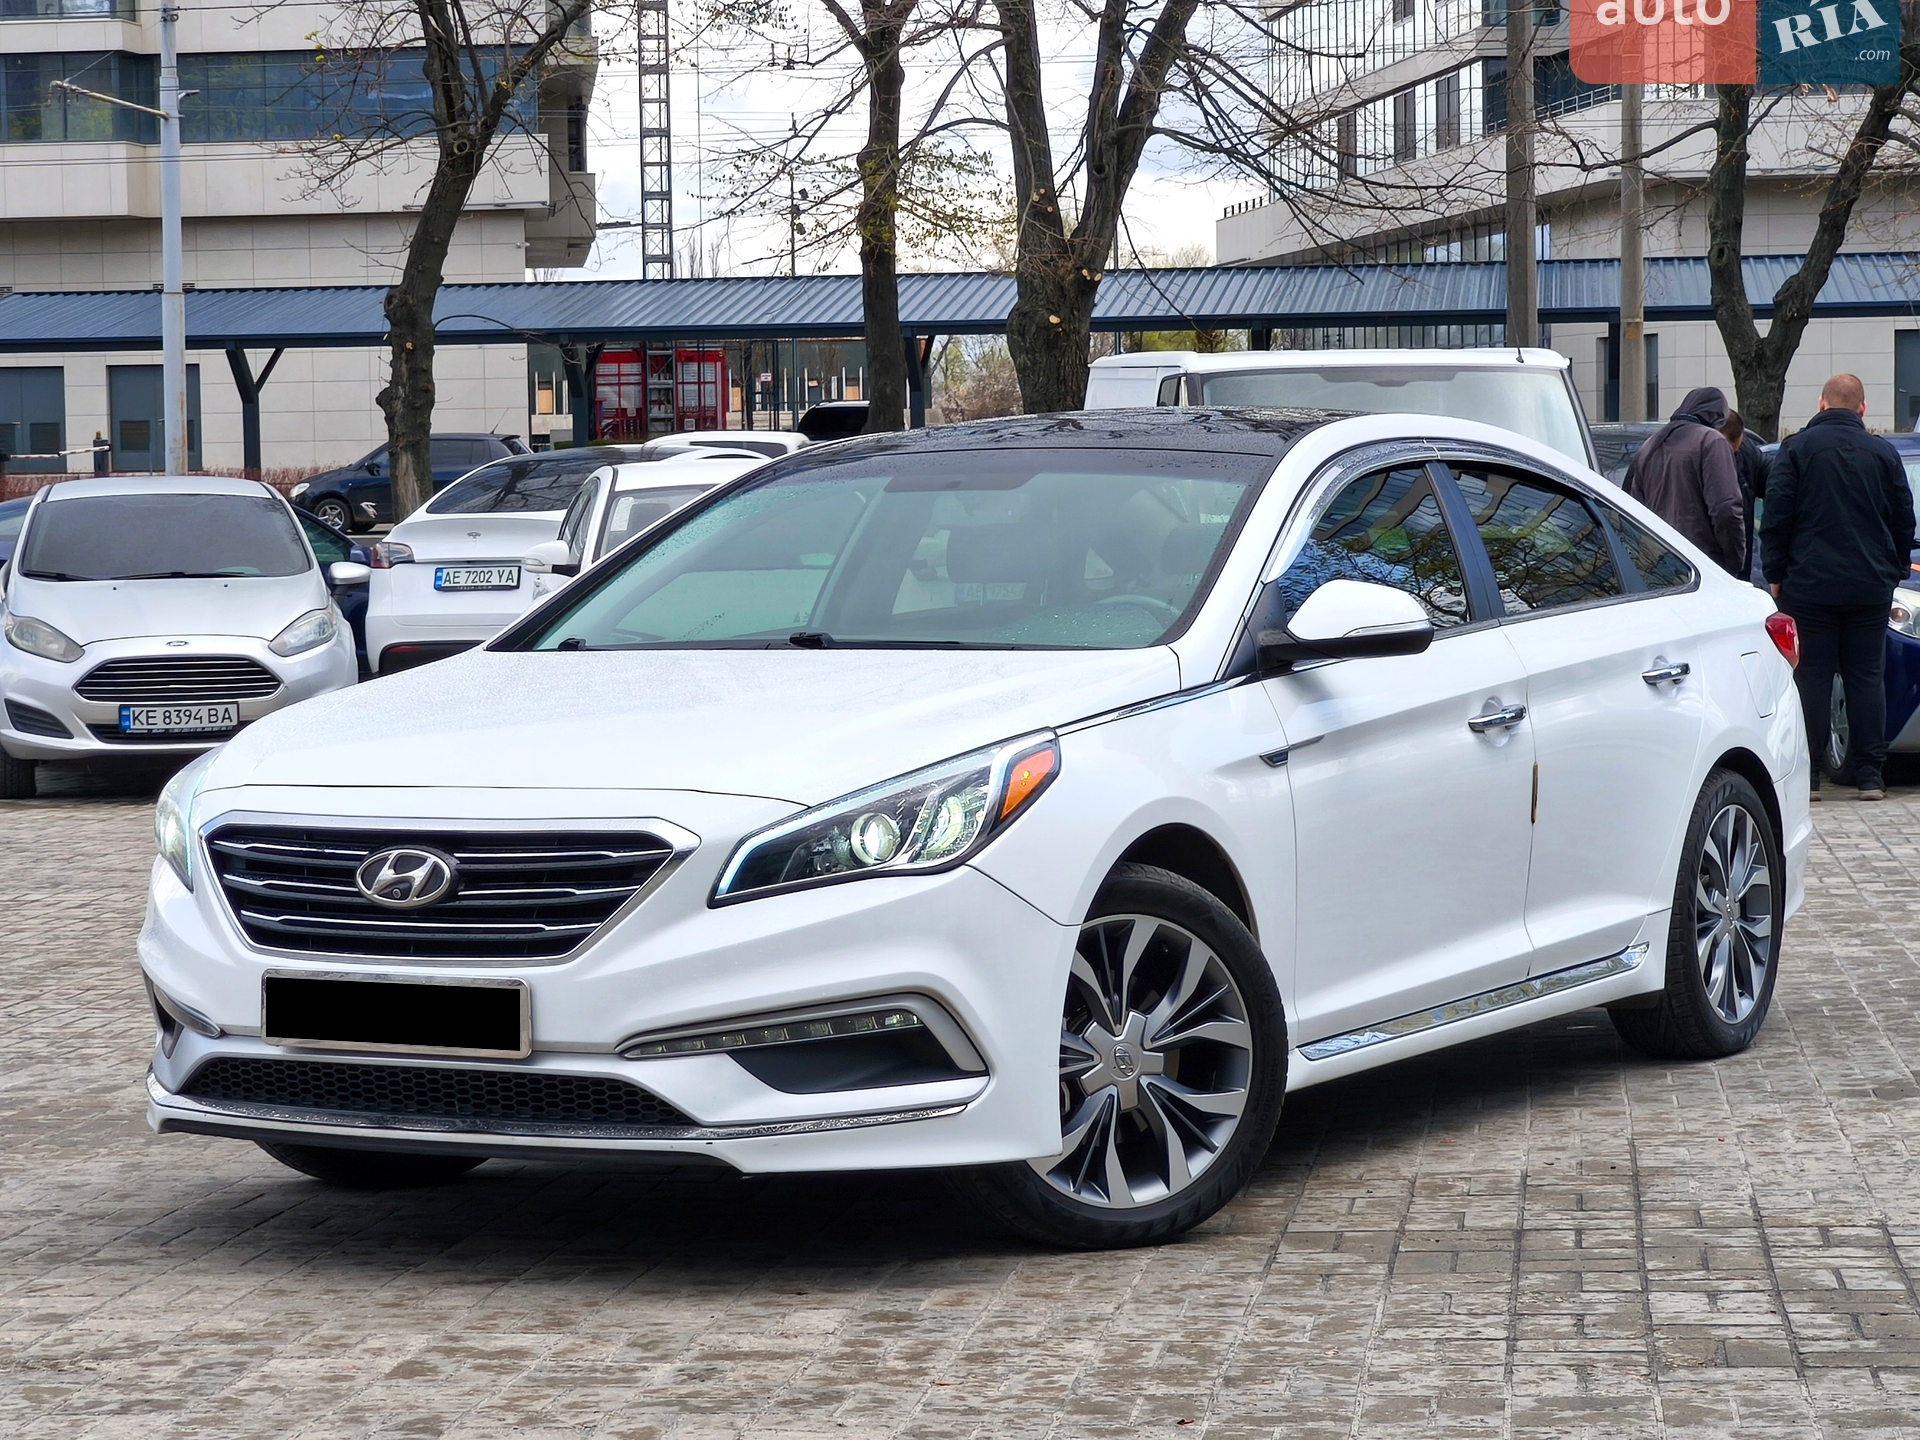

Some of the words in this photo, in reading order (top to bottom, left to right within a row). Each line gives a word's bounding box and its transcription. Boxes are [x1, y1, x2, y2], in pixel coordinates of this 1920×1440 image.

[443, 571, 461, 585] AE
[464, 570, 493, 584] 7202
[497, 569, 515, 583] YA
[132, 709, 158, 726] KE
[162, 708, 203, 726] 8394
[207, 707, 233, 724] BA
